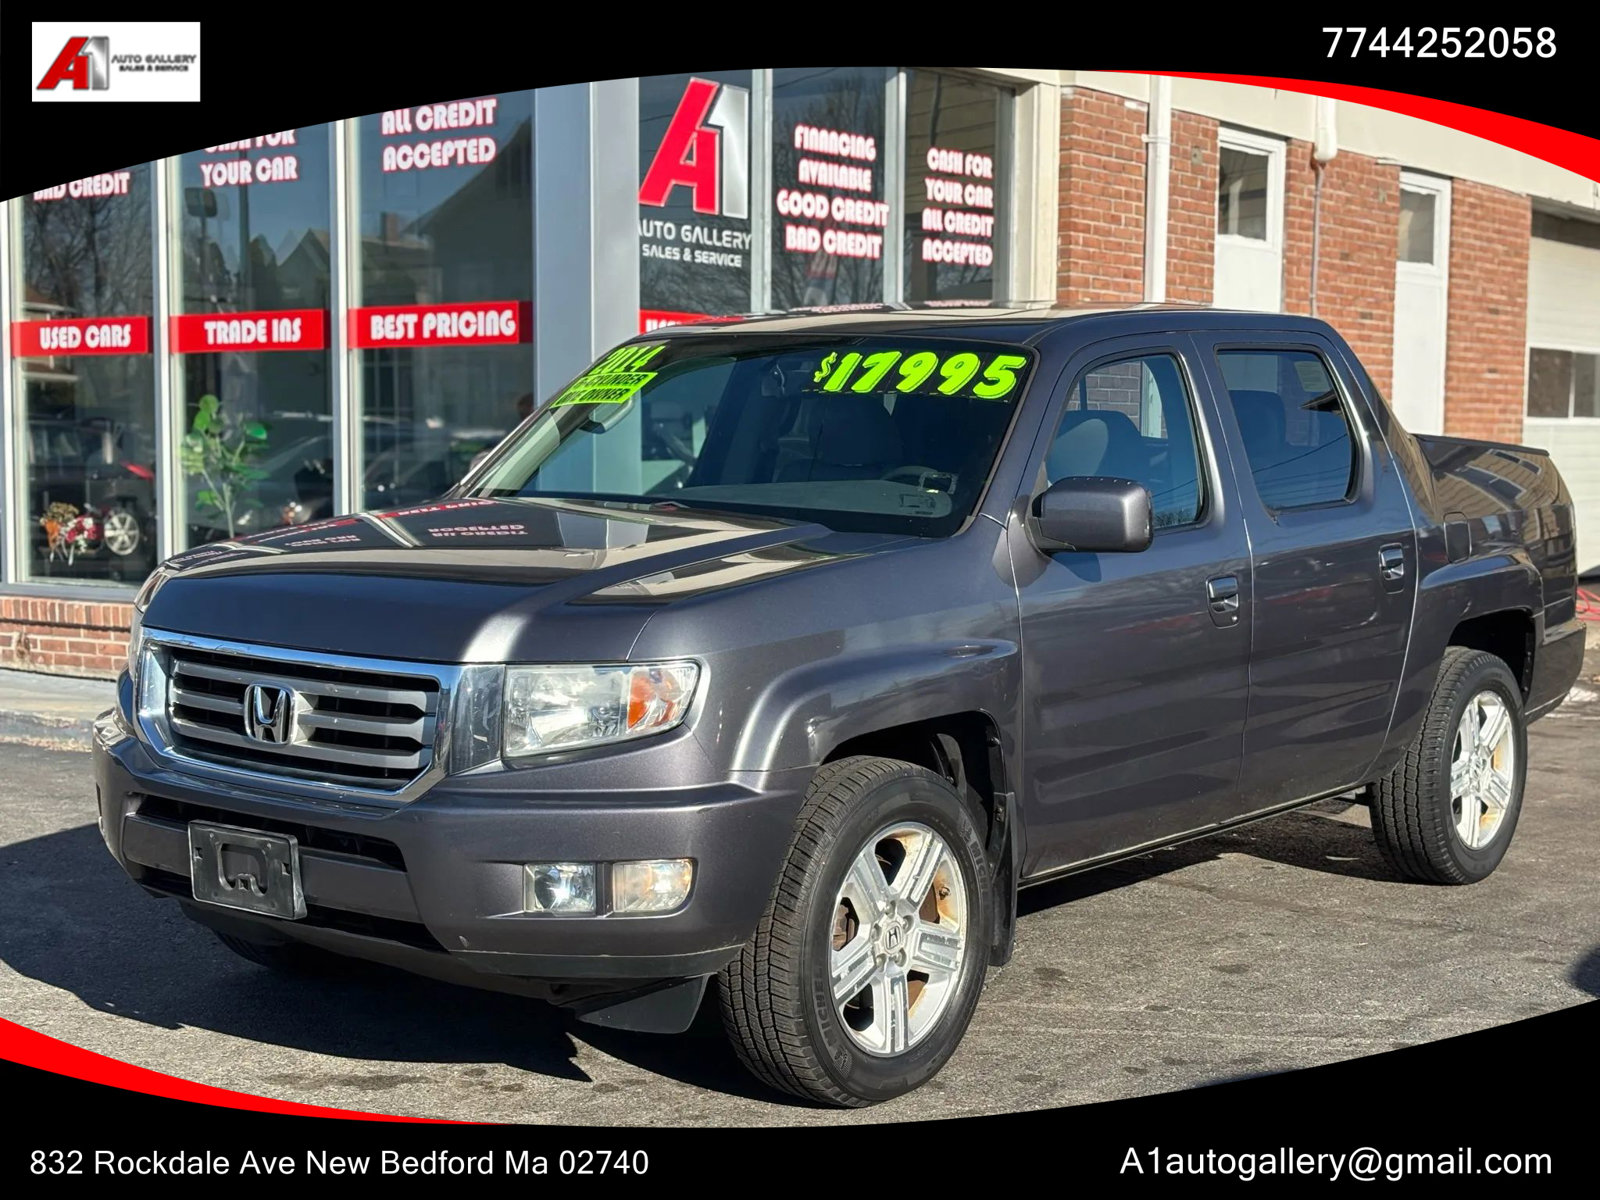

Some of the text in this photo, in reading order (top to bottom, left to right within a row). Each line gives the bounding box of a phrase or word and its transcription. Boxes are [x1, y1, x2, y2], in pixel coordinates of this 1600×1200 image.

[381, 98, 497, 135] ALL CREDIT
[383, 136, 497, 172] ACCEPTED
[638, 76, 749, 219] A1
[794, 124, 877, 161] FINANCING
[200, 155, 298, 187] YOUR CAR
[798, 157, 872, 194] AVAILABLE
[926, 147, 993, 179] CASH FOR
[68, 171, 131, 199] CREDIT
[924, 177, 993, 209] YOUR CAR
[776, 188, 890, 228] GOOD CREDIT
[921, 207, 995, 238] ALL CREDIT
[680, 224, 752, 250] GALLERY
[785, 223, 883, 260] BAD CREDIT
[921, 237, 994, 268] ACCEPTED
[642, 242, 742, 268] SALES & SERVICE
[39, 323, 132, 350] USED CARS
[204, 317, 302, 345] TRADE INS
[370, 309, 517, 341] BEST PRICING
[814, 351, 1027, 399] $17995
